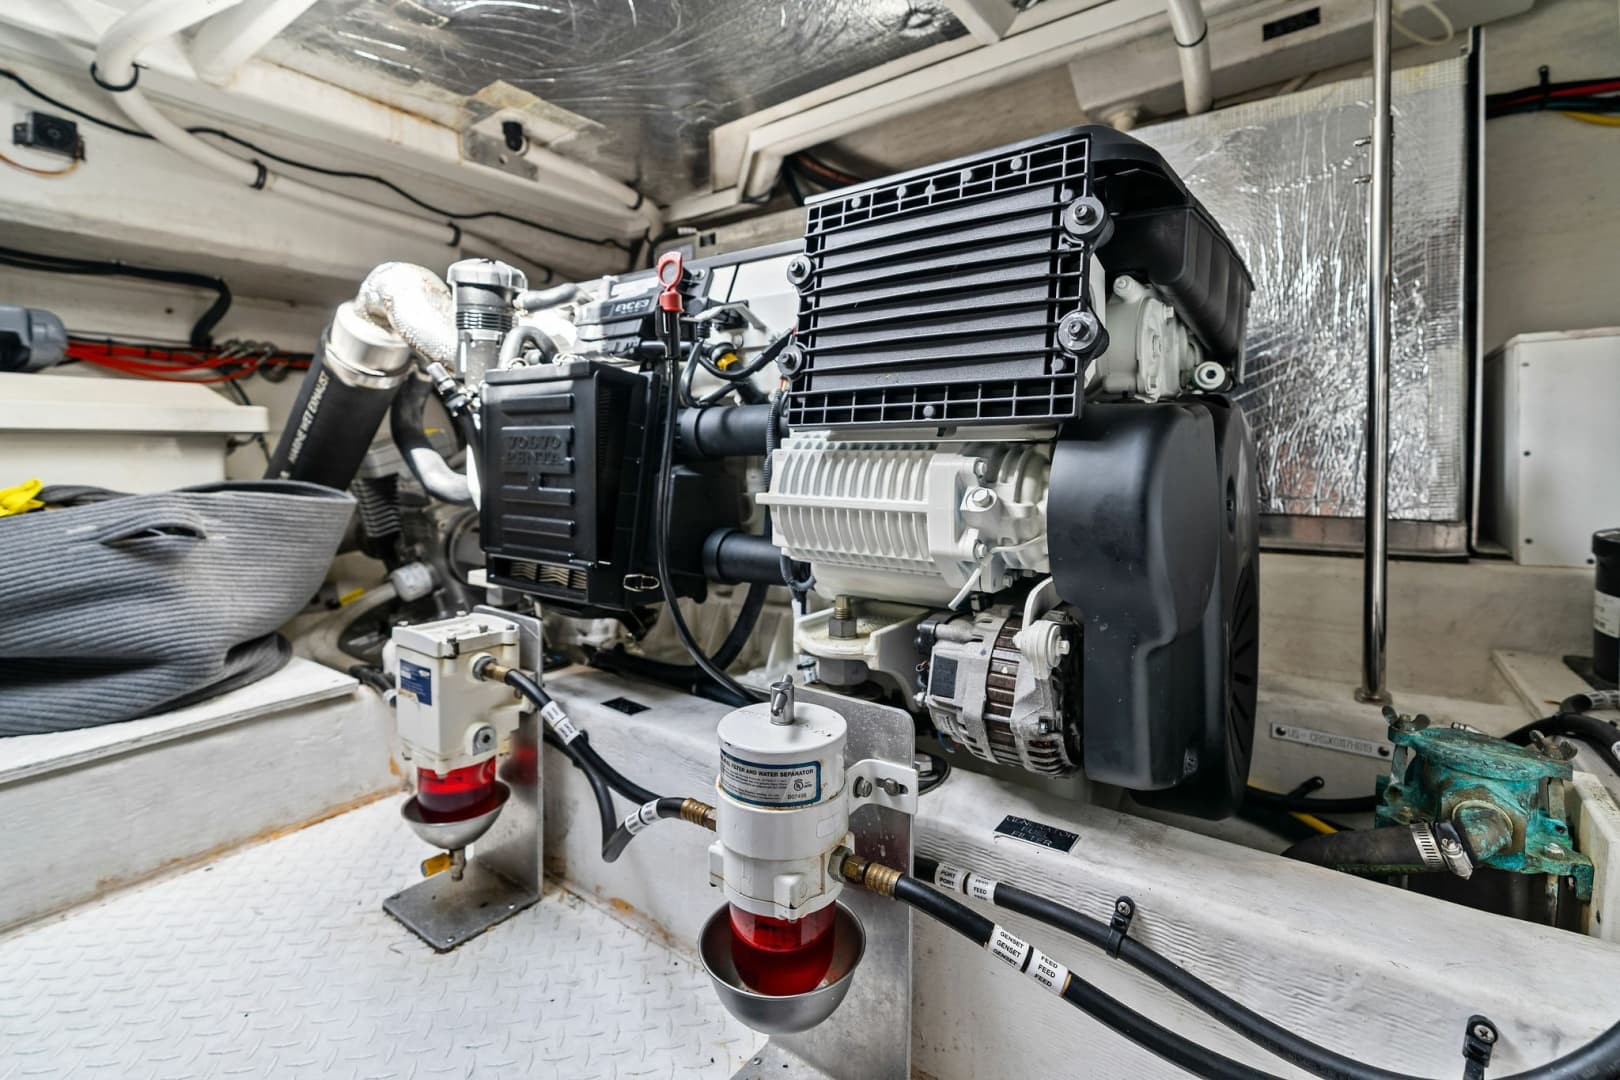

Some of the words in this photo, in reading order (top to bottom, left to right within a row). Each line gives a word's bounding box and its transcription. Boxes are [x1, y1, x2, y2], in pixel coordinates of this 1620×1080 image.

[507, 435, 562, 450] VOLVO
[746, 768, 757, 776] AND
[779, 768, 814, 778] SEPARATOR
[973, 886, 987, 895] FEED
[1000, 931, 1024, 949] GENSET
[1041, 956, 1058, 969] FEED
[996, 939, 1021, 958] GENSET
[1038, 964, 1056, 978] FEED
[1034, 973, 1052, 987] FEED
